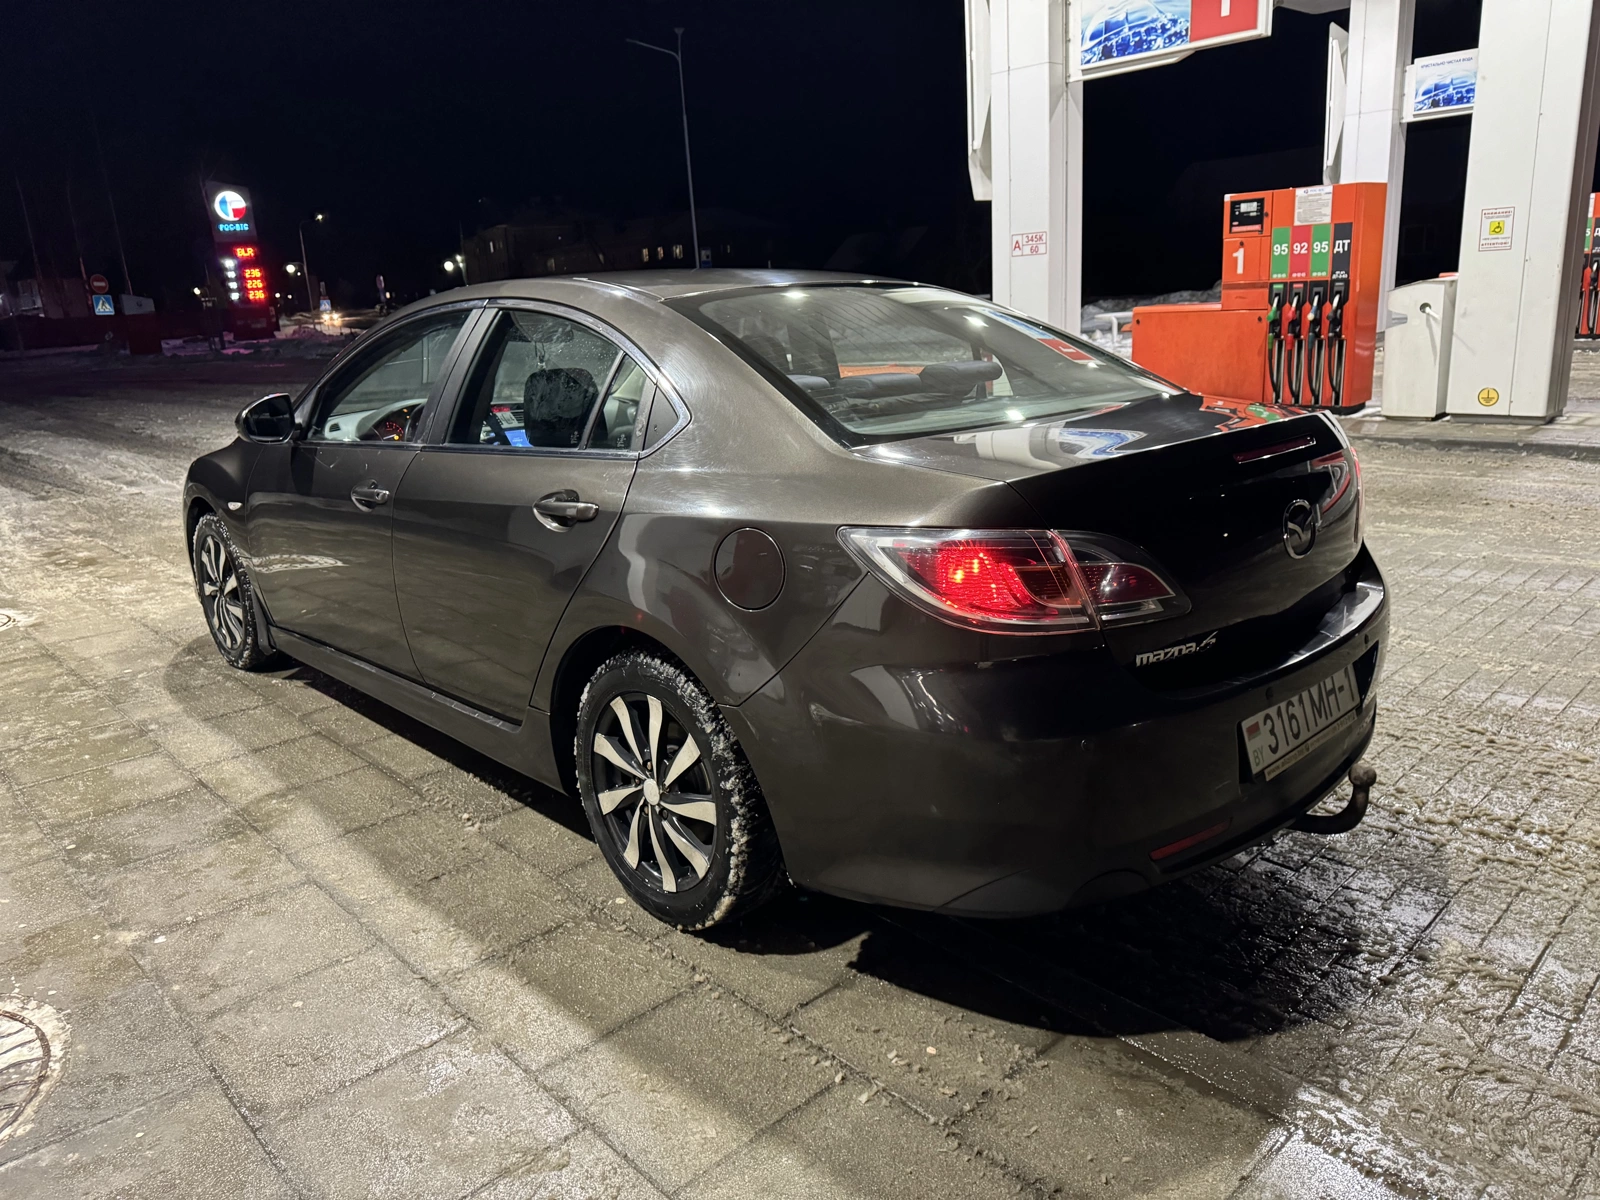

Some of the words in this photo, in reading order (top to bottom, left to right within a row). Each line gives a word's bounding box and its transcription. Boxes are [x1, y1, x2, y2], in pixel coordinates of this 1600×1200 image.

[236, 247, 254, 257] BLR
[1013, 240, 1021, 251] A
[1030, 245, 1039, 254] 60
[1273, 243, 1289, 256] 95
[1293, 242, 1308, 255] 92
[1313, 240, 1329, 253] 95
[1334, 239, 1350, 254] ДТ
[1232, 247, 1244, 275] 1
[245, 269, 261, 278] 236
[249, 290, 265, 300] 236
[1253, 745, 1265, 767] BY
